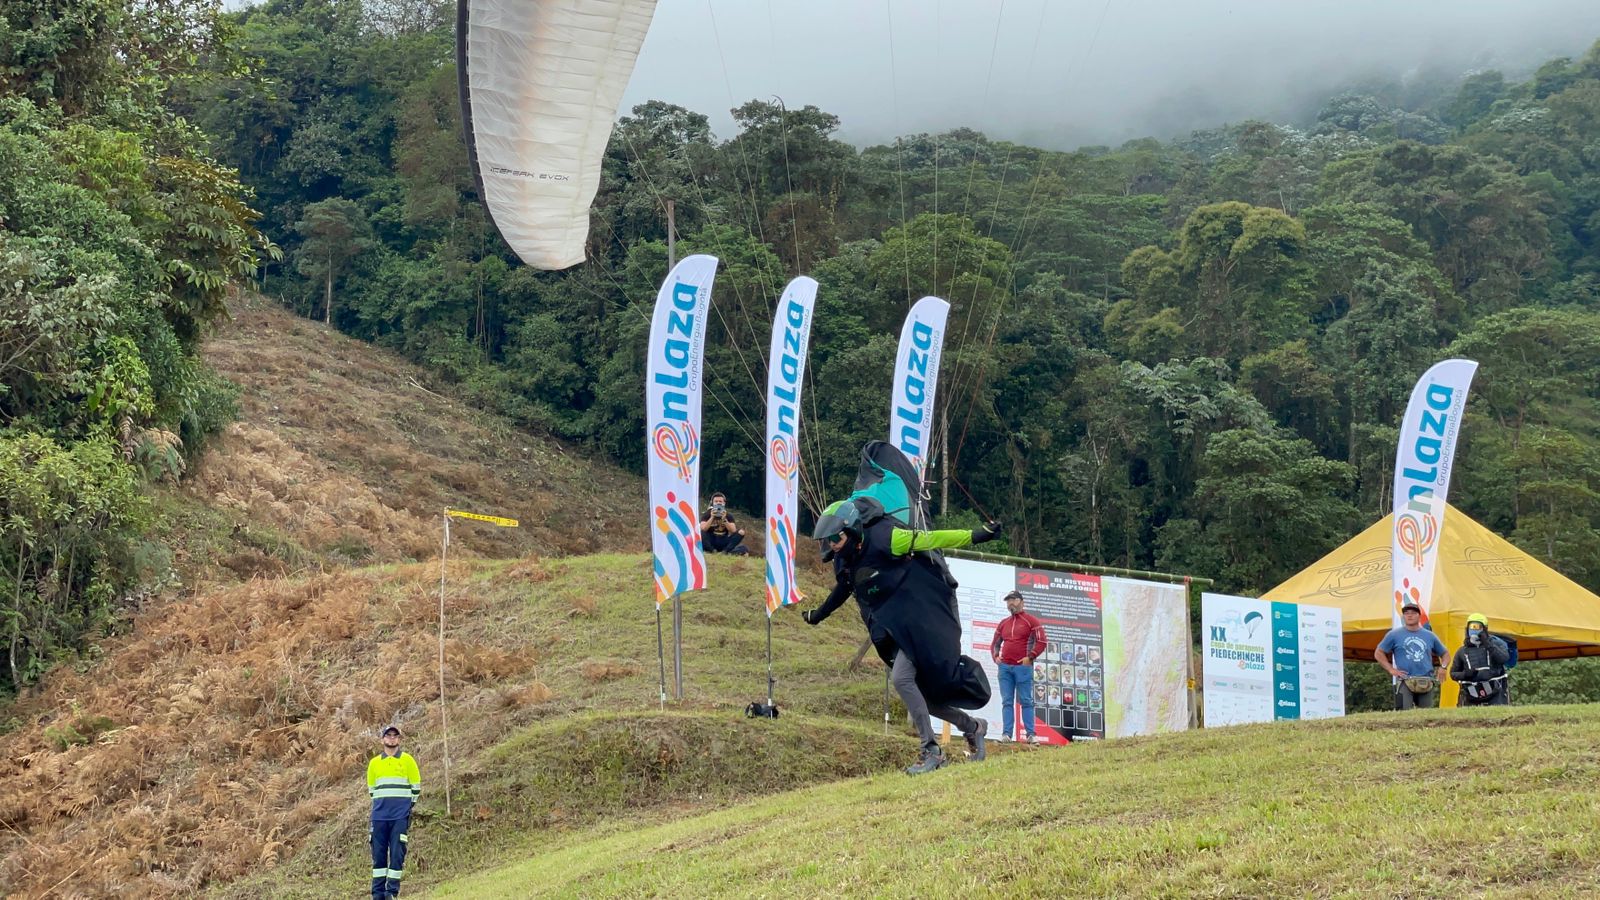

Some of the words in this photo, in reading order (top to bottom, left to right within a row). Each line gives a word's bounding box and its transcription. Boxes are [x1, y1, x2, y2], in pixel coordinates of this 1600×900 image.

[539, 173, 570, 181] EVOX
[897, 320, 934, 462] nlaza
[1018, 572, 1049, 585] 20
[1210, 626, 1226, 642] XX
[1210, 648, 1265, 663] PIEDECHINCHE
